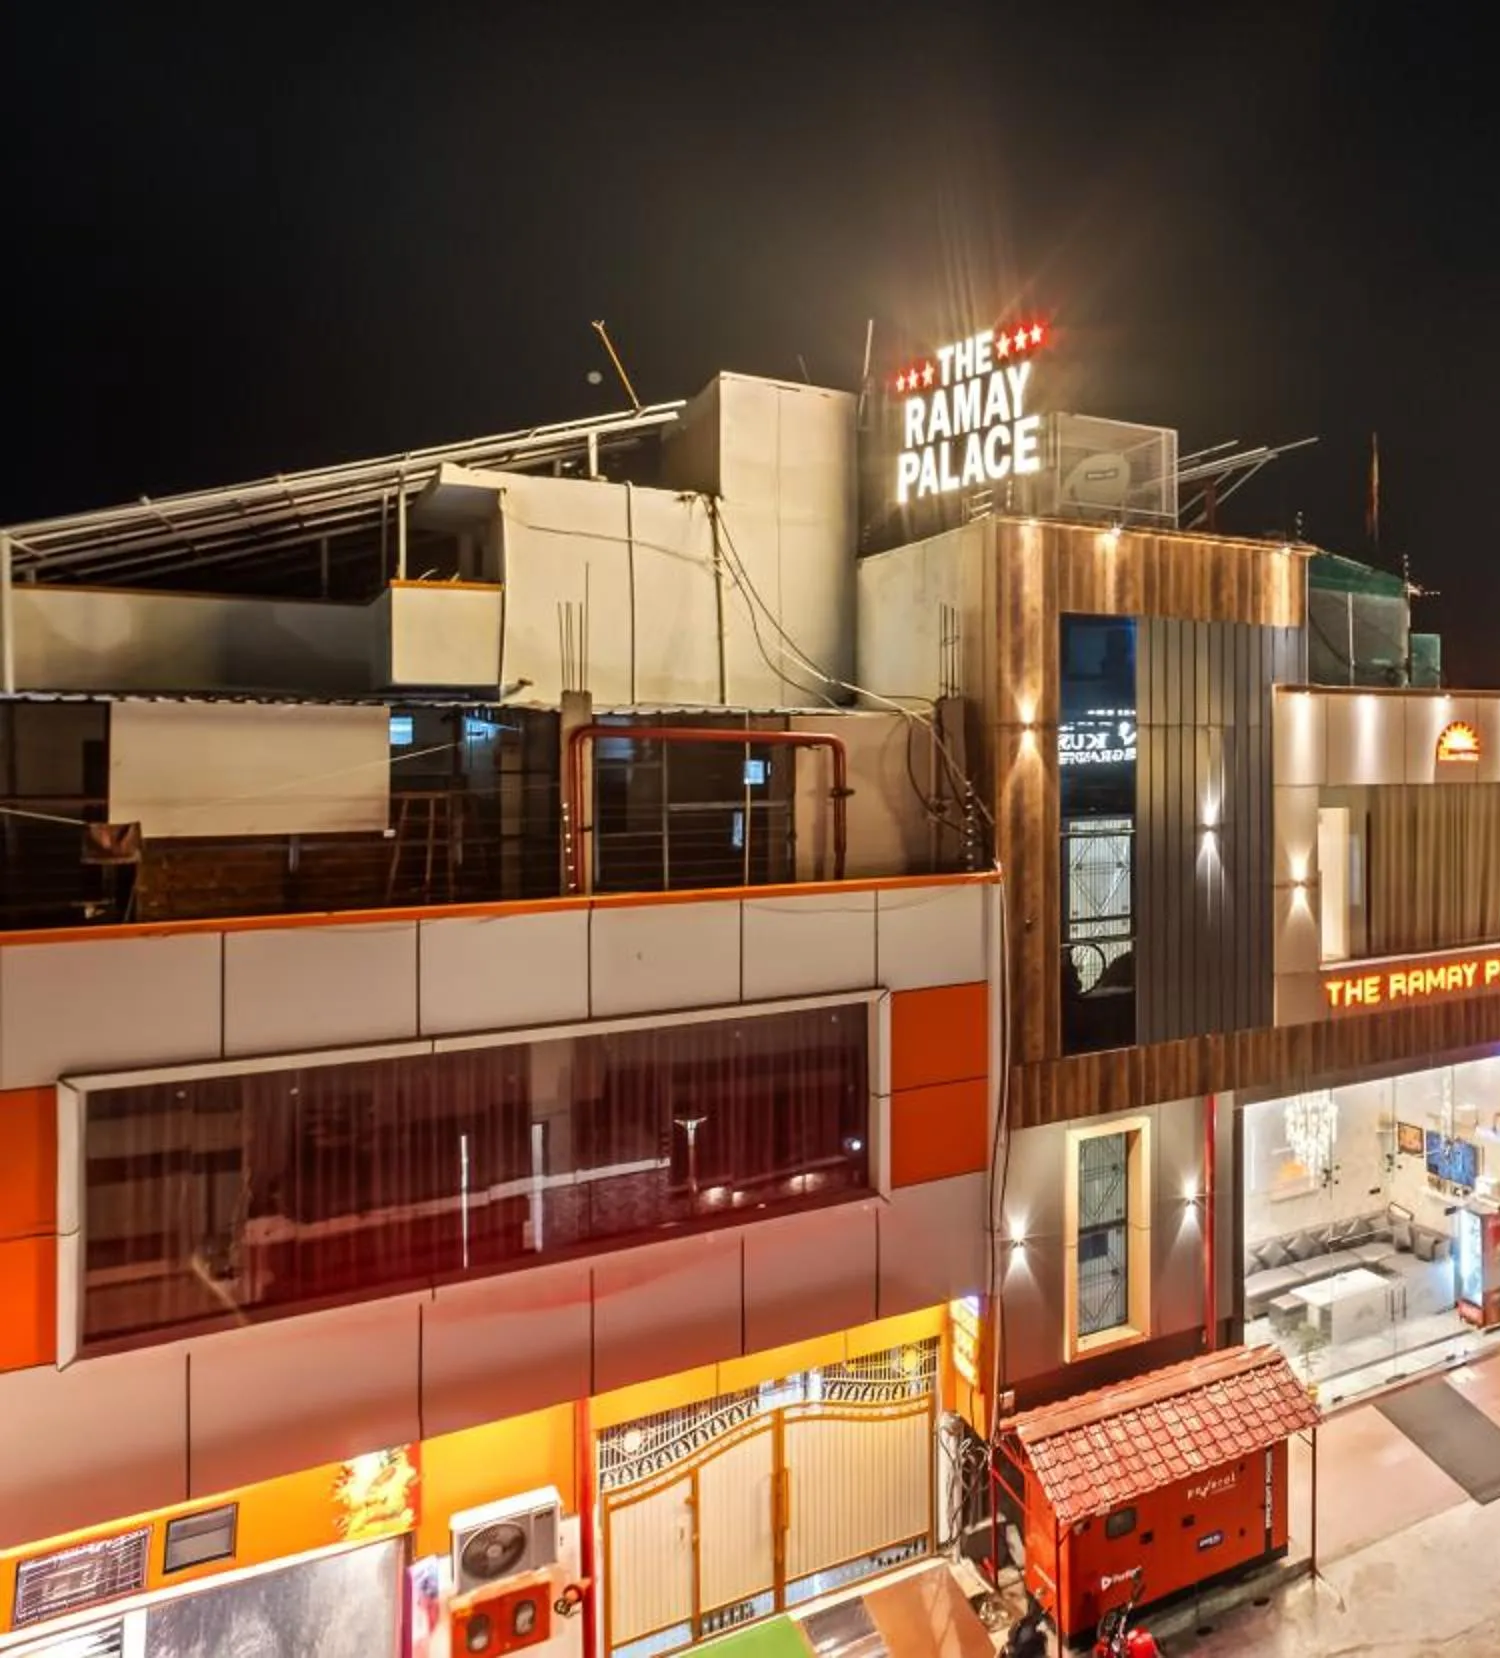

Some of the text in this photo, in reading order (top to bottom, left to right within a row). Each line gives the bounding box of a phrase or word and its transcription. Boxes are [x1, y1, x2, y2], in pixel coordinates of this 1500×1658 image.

[937, 330, 994, 387] THE
[904, 361, 1032, 449] RAMAY
[896, 414, 1041, 504] PALACE
[1326, 976, 1381, 1007] THE
[1388, 961, 1478, 1000] RAMAY
